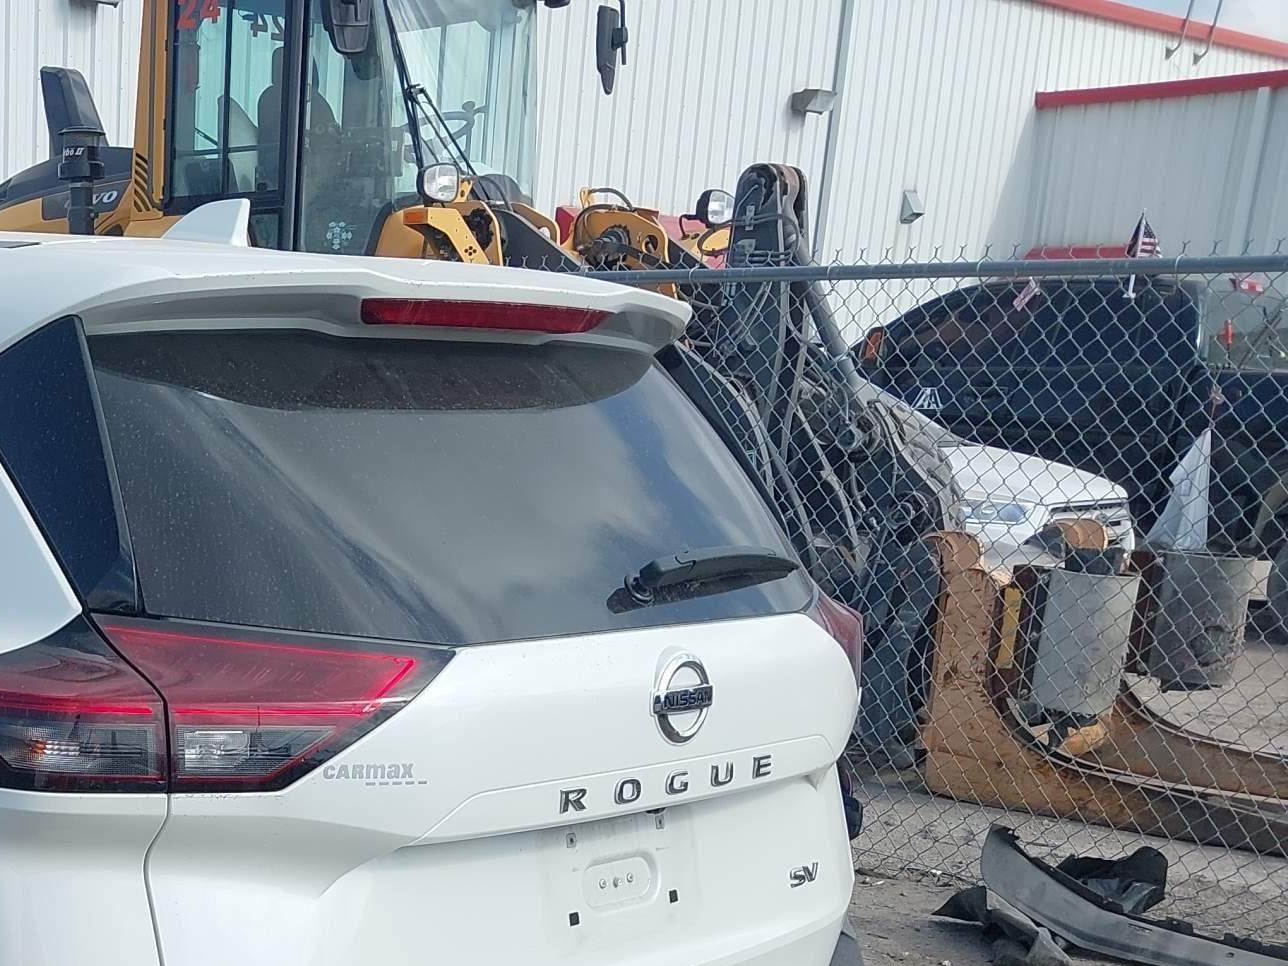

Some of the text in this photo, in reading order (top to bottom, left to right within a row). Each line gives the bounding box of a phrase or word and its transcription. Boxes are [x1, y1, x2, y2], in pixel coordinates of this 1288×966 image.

[663, 688, 712, 709] NISSAN
[559, 754, 773, 814] ROGUE
[789, 862, 819, 888] SV
